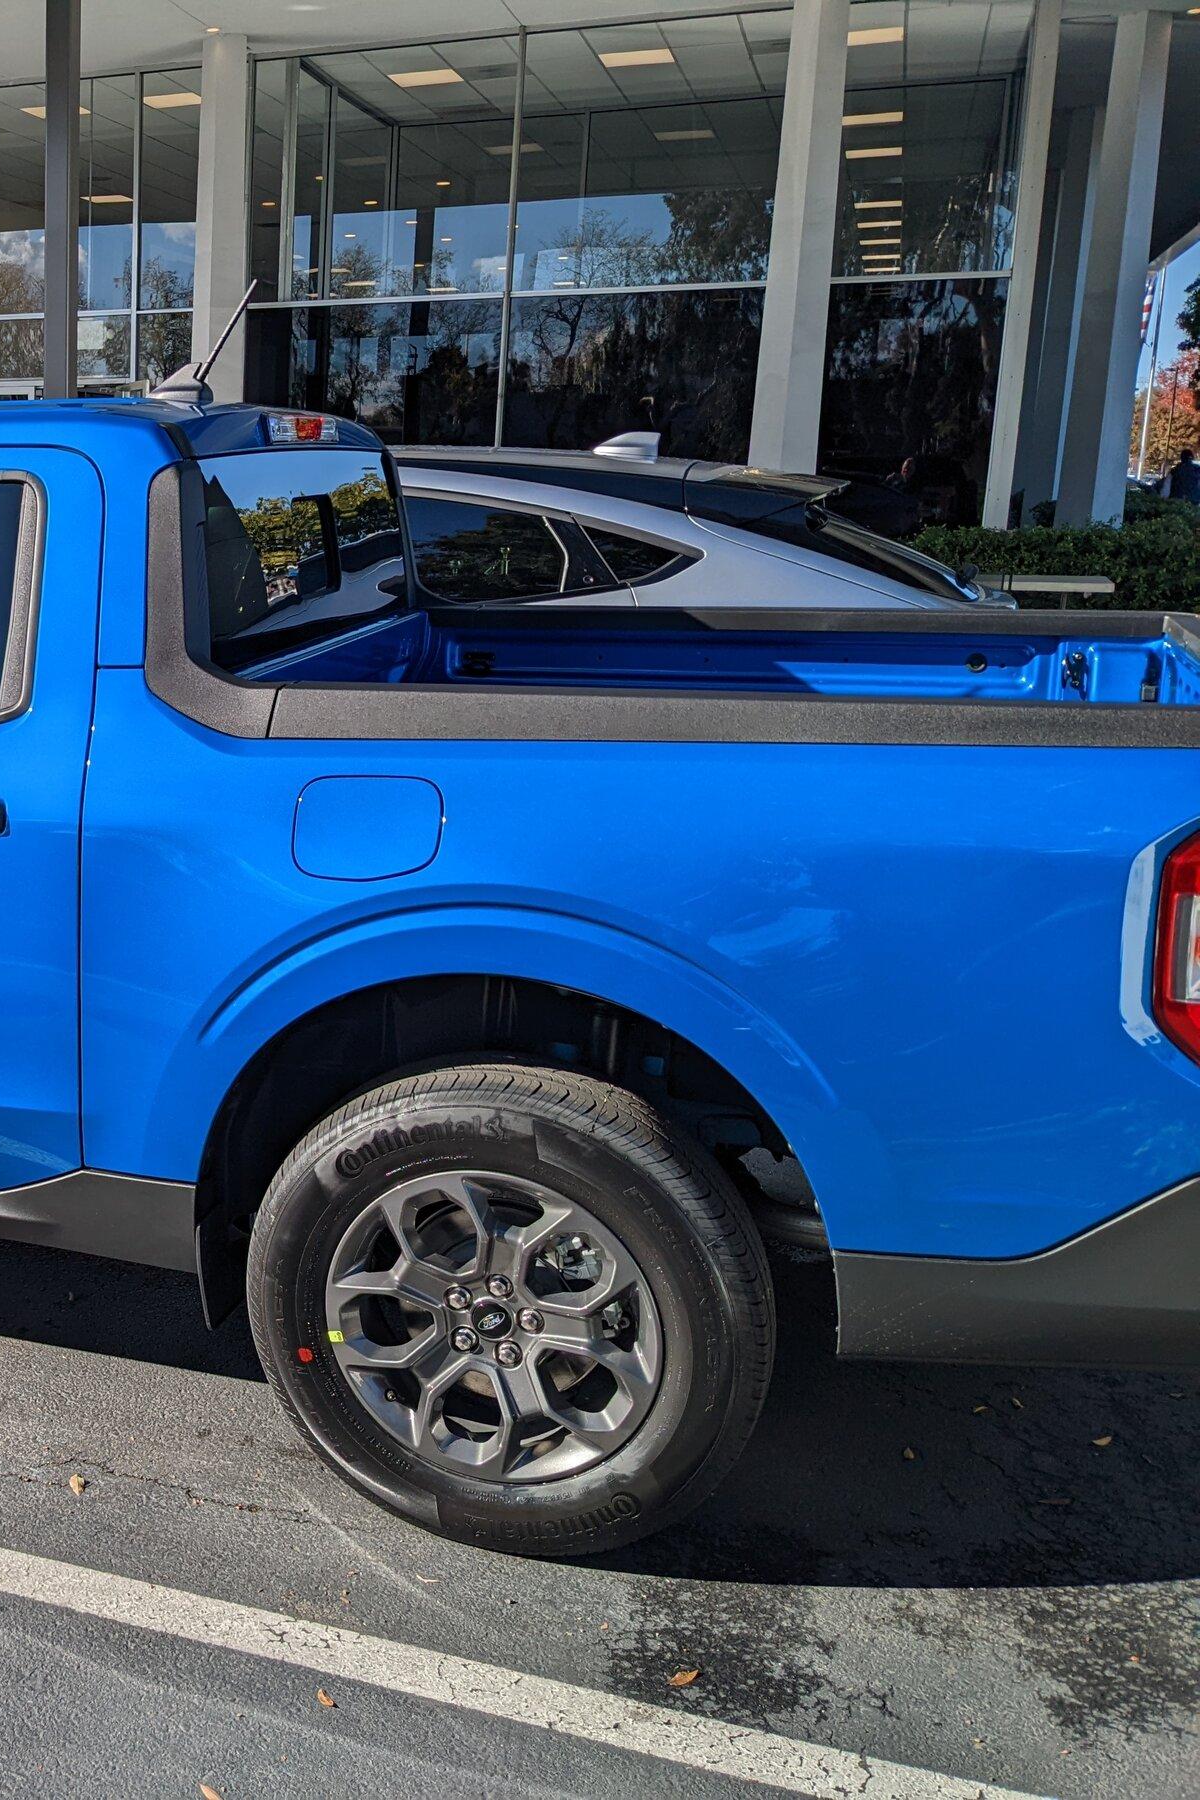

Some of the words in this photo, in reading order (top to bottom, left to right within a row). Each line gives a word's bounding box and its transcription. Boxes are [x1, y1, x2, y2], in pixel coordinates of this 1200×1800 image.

[335, 1115, 482, 1178] Continental
[482, 1314, 501, 1328] Ford
[490, 1491, 641, 1541] Continental
